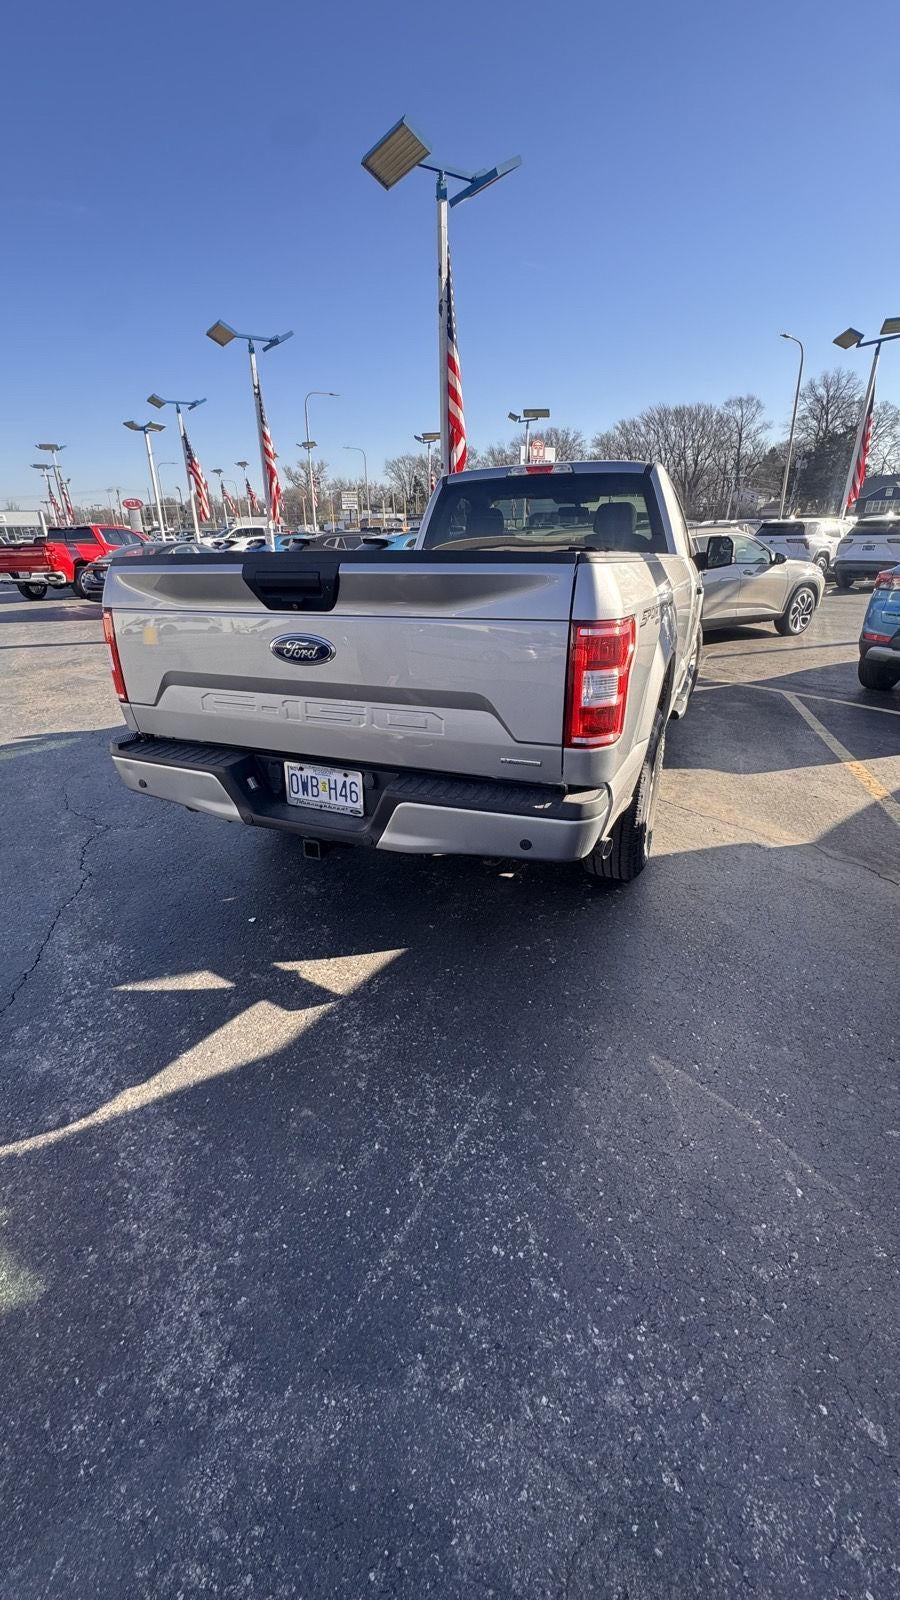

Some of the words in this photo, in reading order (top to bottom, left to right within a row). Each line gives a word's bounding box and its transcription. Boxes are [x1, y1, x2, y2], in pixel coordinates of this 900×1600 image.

[283, 640, 317, 659] Ford
[201, 692, 445, 736] F-150
[327, 779, 359, 804] H46
